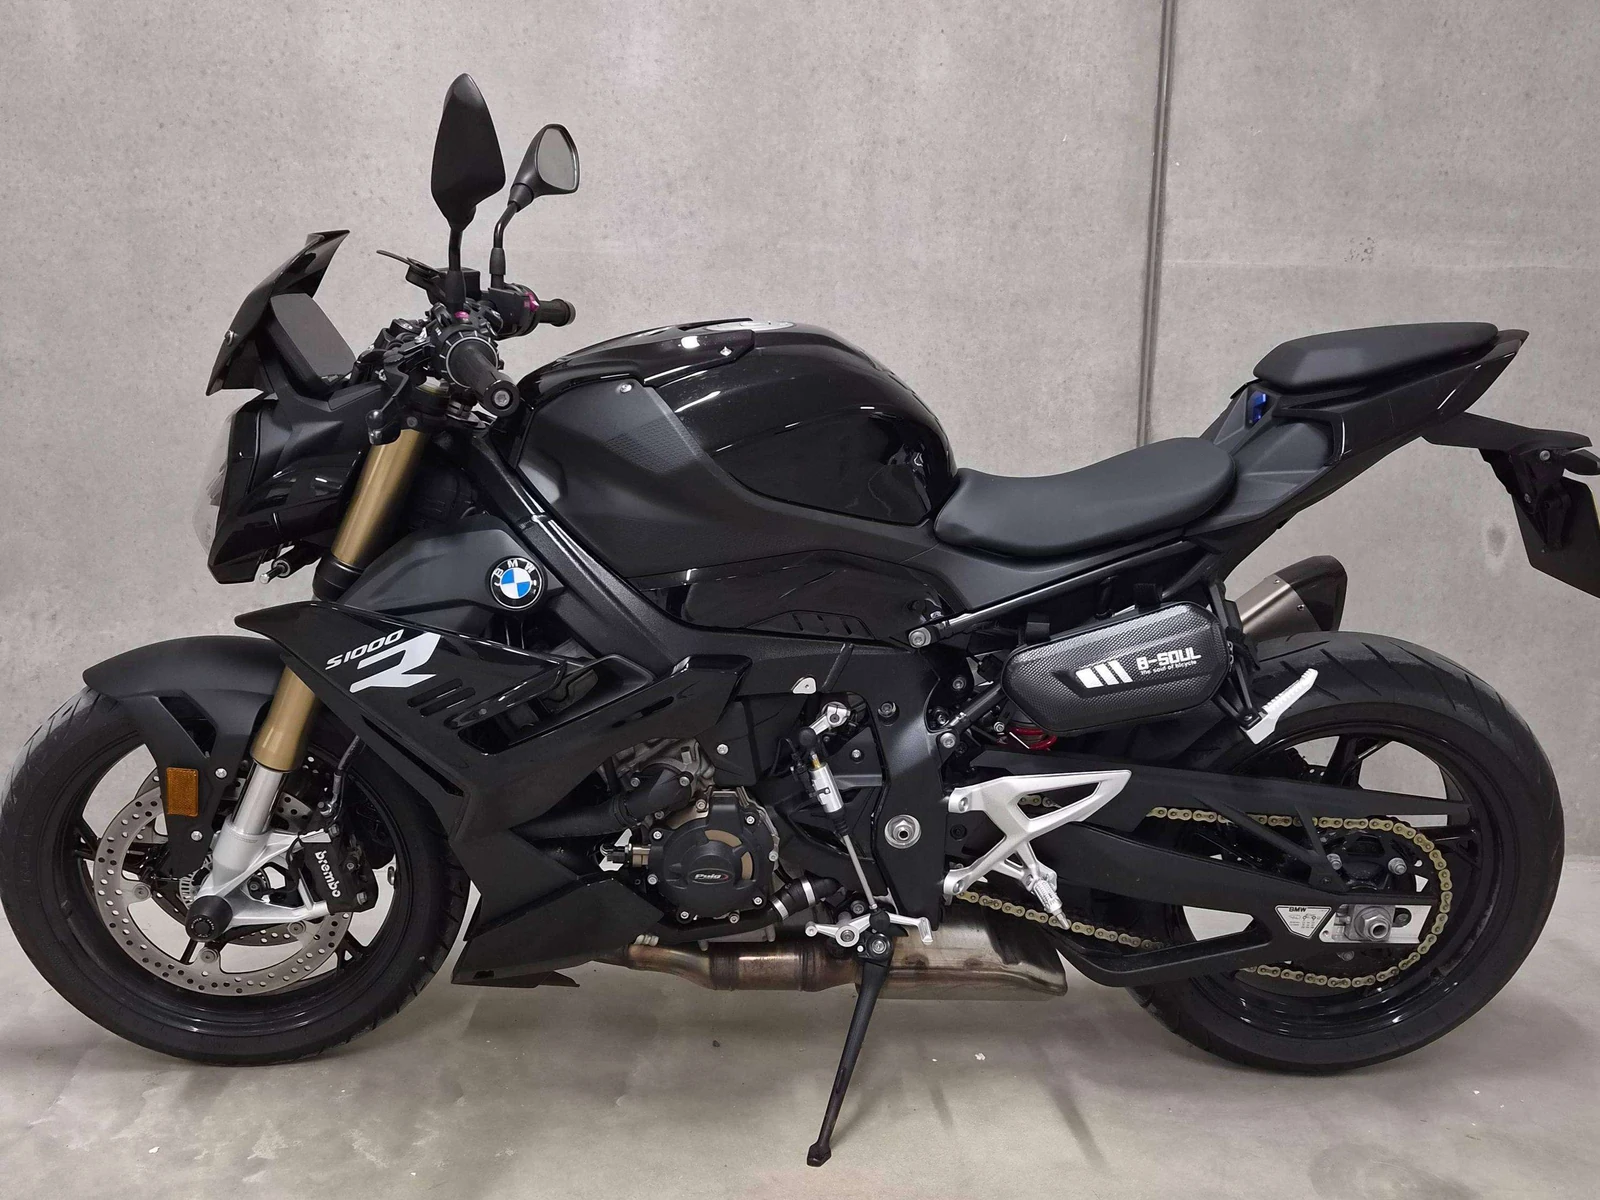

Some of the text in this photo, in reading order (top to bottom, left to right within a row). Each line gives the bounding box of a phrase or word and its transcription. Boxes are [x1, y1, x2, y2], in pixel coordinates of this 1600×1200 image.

[493, 559, 536, 578] BMW
[325, 628, 404, 670] S1000
[1136, 647, 1201, 670] B-SOUL
[1175, 660, 1197, 668] bicycle
[315, 850, 341, 897] brembo
